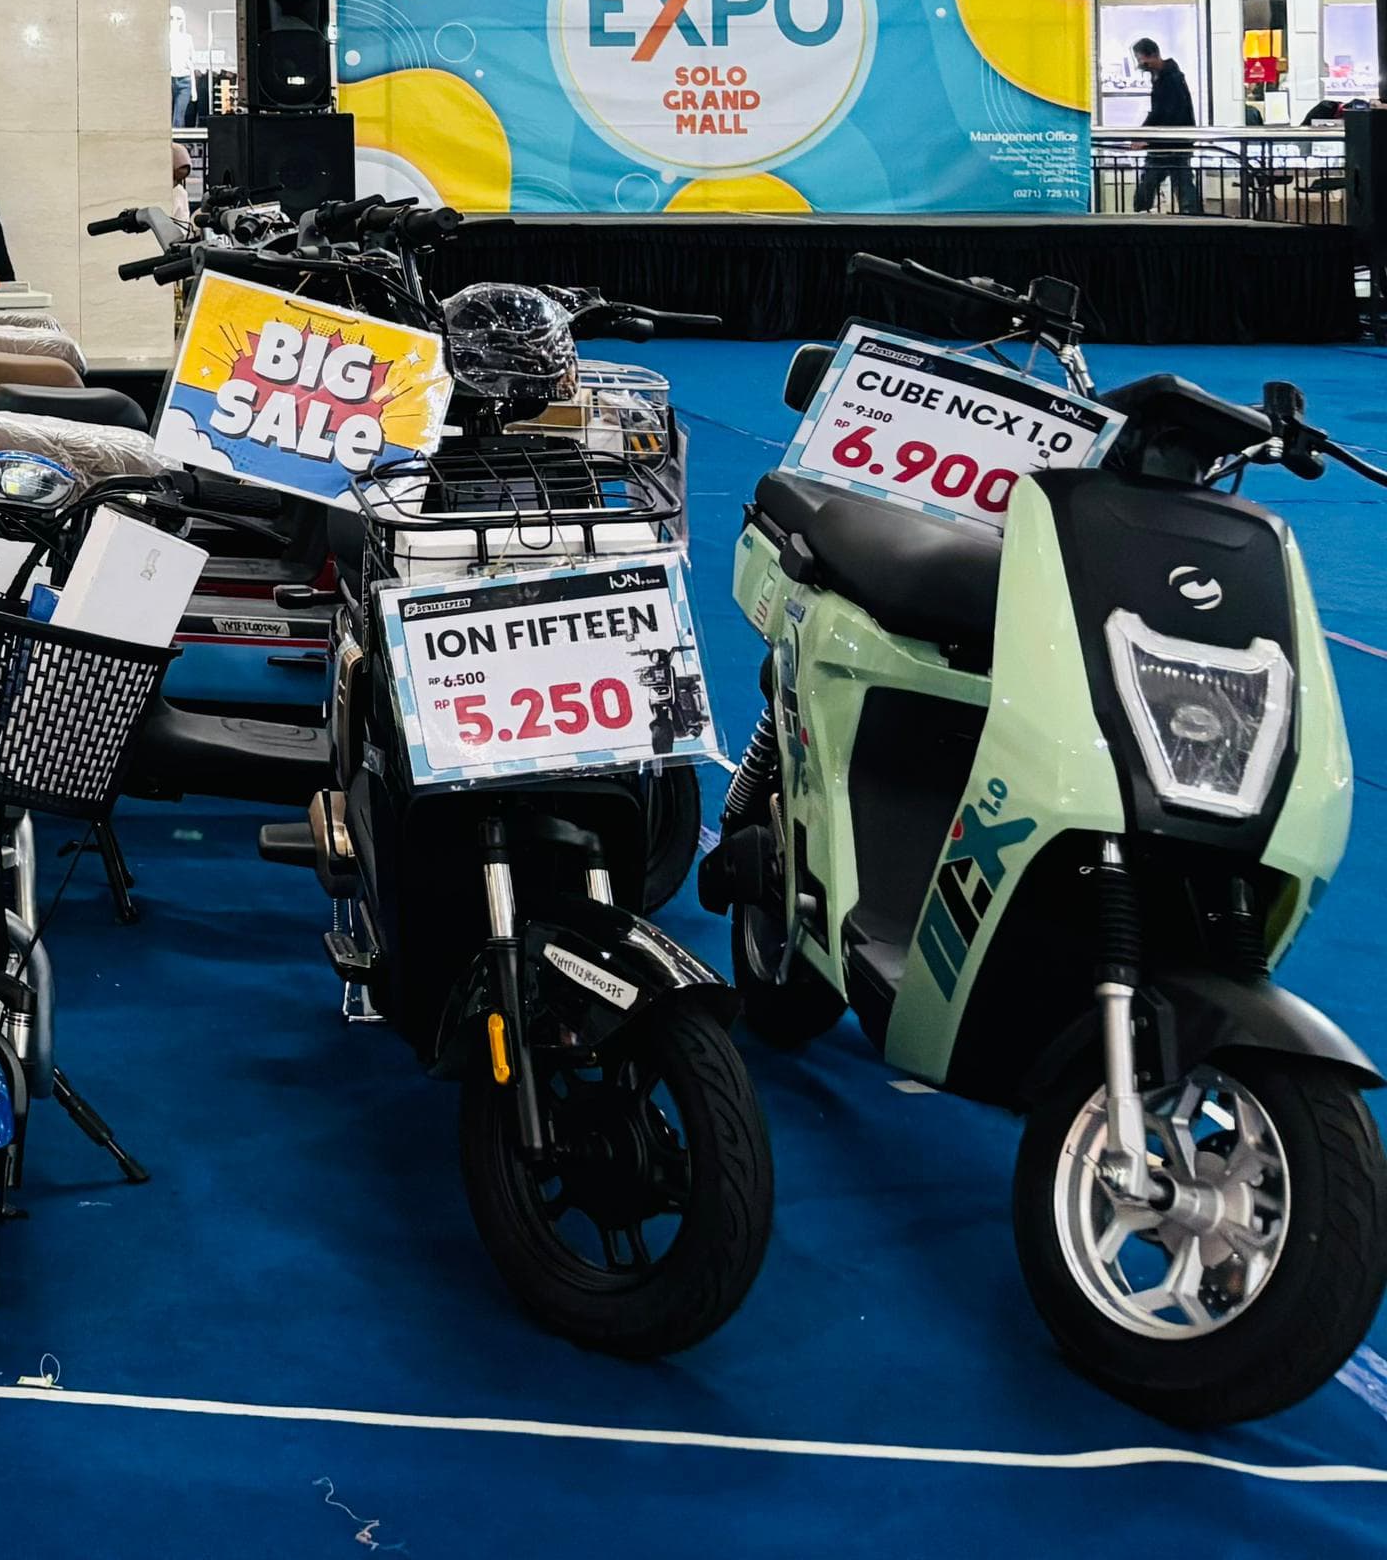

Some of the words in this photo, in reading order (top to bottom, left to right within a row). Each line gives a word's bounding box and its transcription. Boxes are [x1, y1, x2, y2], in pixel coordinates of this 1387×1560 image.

[674, 66, 748, 87] SOLO
[662, 89, 761, 111] GRAND
[676, 113, 748, 135] MALL
[970, 131, 1043, 144] Management
[1045, 131, 1078, 142] Office
[1013, 189, 1042, 199] (0271)
[252, 320, 376, 402] BIG
[855, 404, 893, 424] 9.100
[856, 370, 945, 411] CUBE
[945, 394, 1025, 437] NCX
[1025, 420, 1074, 454] 1.0
[1049, 398, 1081, 421] ION
[834, 417, 851, 429] RP
[831, 425, 1020, 513] 6.900
[609, 571, 641, 590] ION
[425, 624, 498, 661] ION
[505, 603, 660, 652] FIFTEEN
[428, 677, 442, 687] RP
[443, 670, 486, 689] 6.500
[434, 698, 451, 711] RP
[453, 676, 634, 746] 5.250
[978, 776, 1009, 818] 1.0
